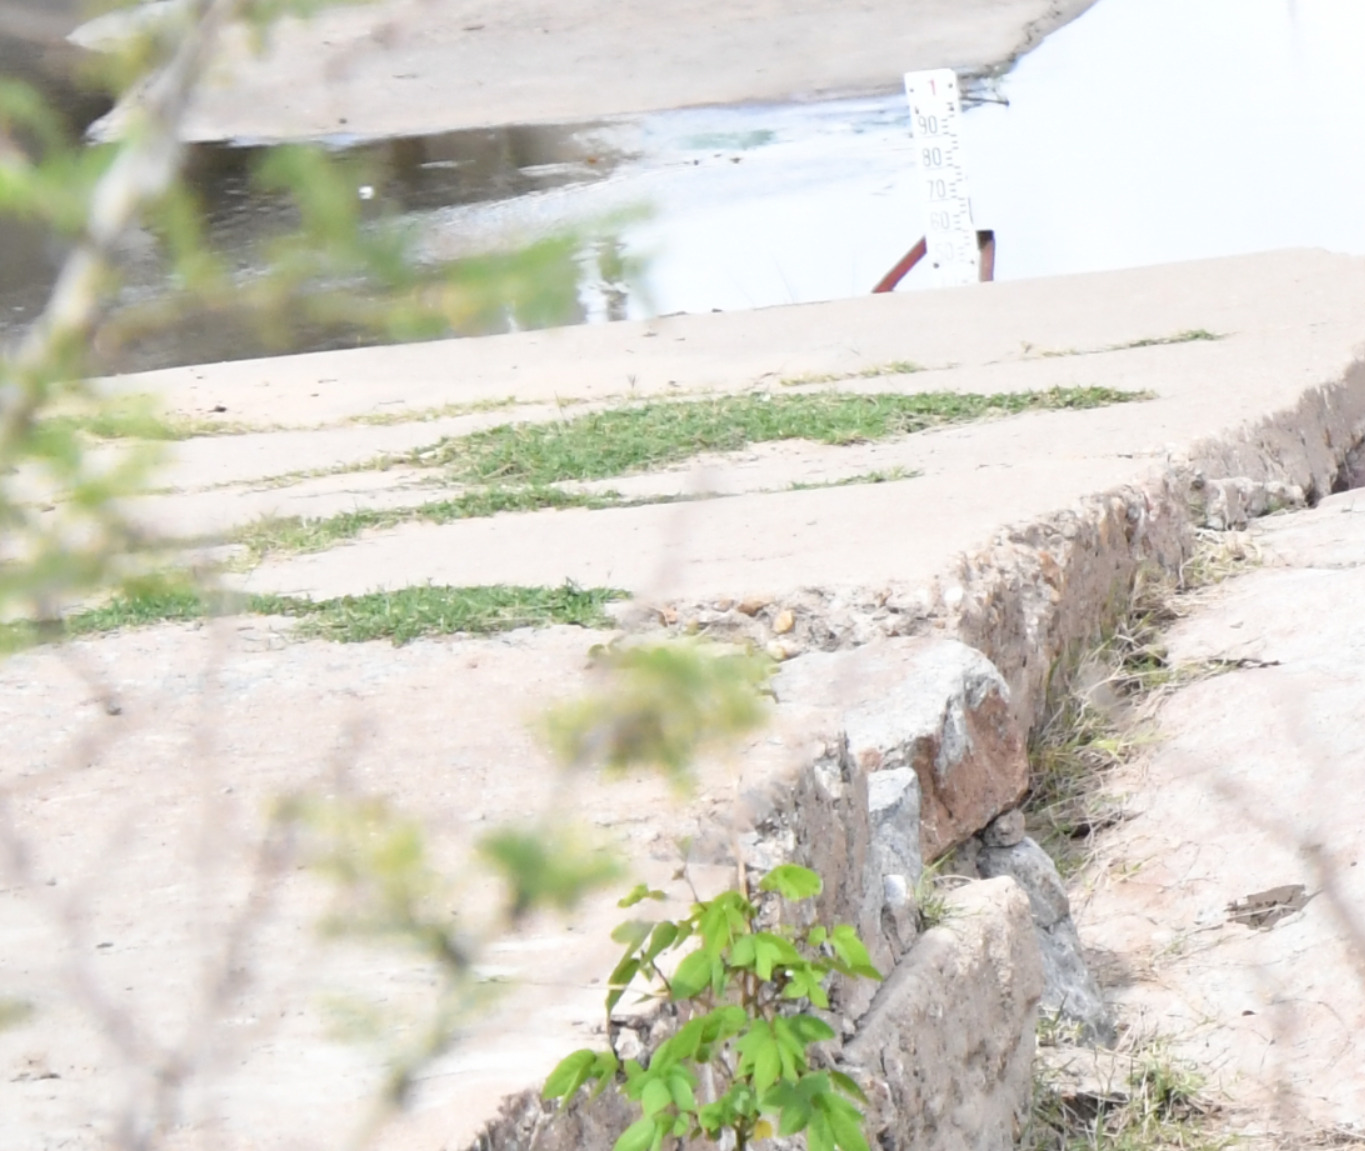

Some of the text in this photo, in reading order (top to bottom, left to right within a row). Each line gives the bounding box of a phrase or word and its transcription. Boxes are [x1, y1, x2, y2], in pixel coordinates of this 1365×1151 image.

[928, 79, 936, 96] 1
[918, 115, 939, 135] 90
[922, 147, 943, 167] 80
[926, 179, 946, 199] 70
